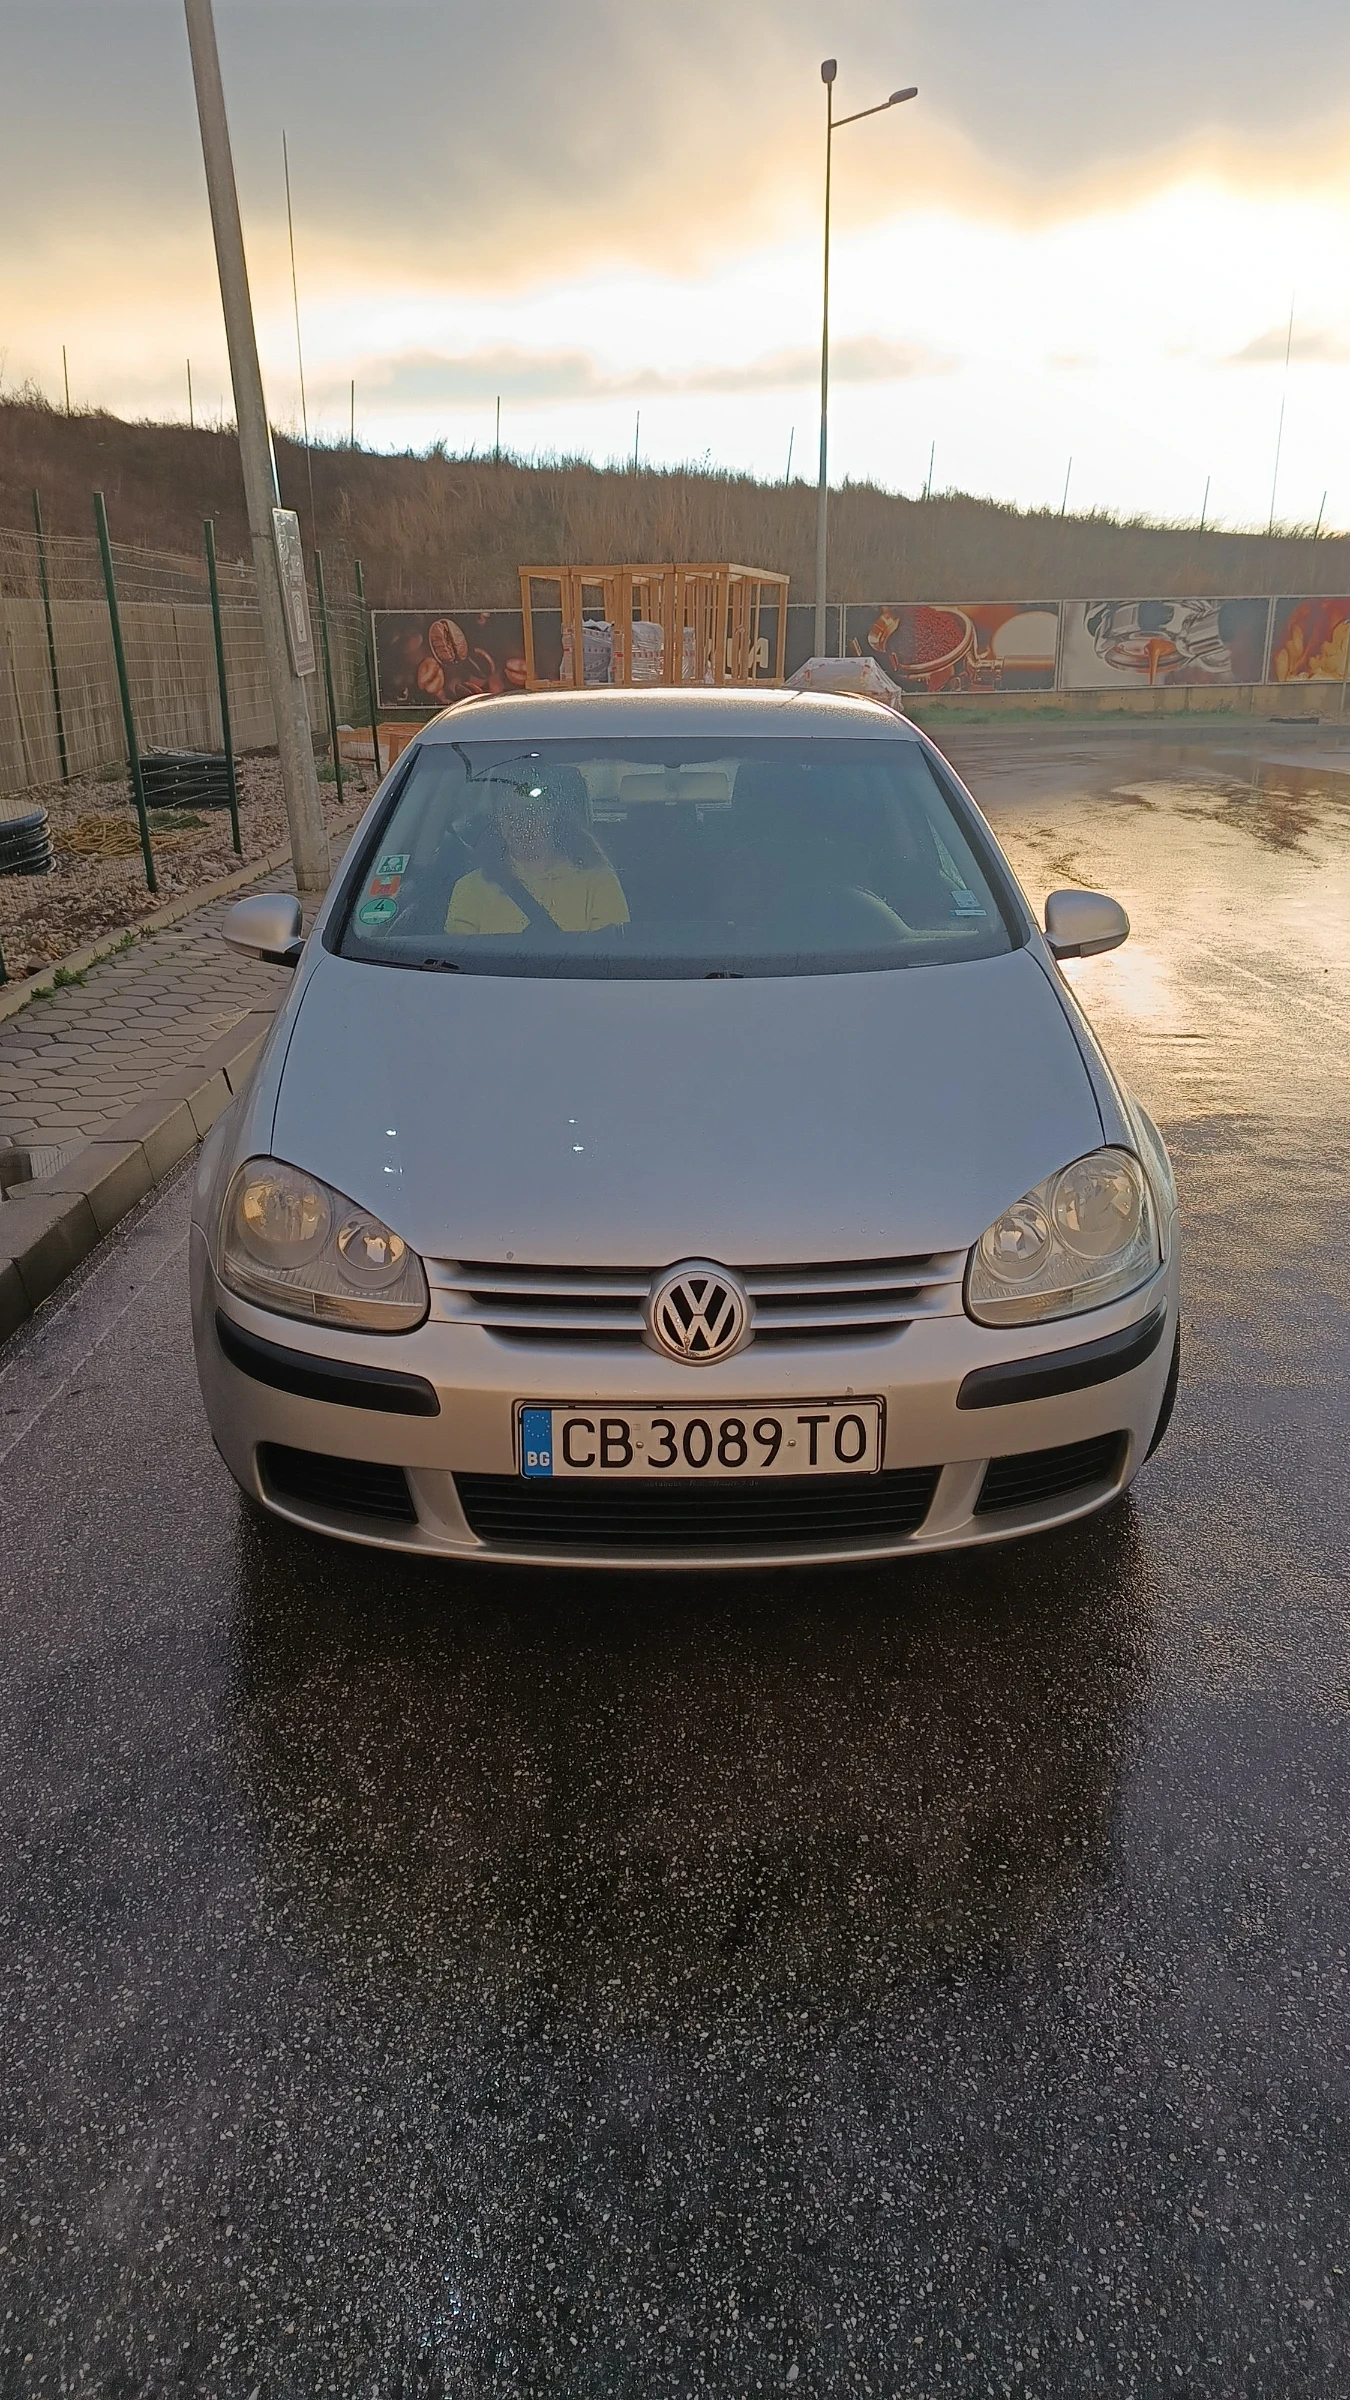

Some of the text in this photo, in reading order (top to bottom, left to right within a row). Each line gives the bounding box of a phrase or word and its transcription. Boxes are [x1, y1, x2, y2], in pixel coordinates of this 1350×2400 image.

[374, 899, 385, 911] 4
[562, 1414, 867, 1468] CB 3089 TO
[526, 1451, 550, 1467] BG
